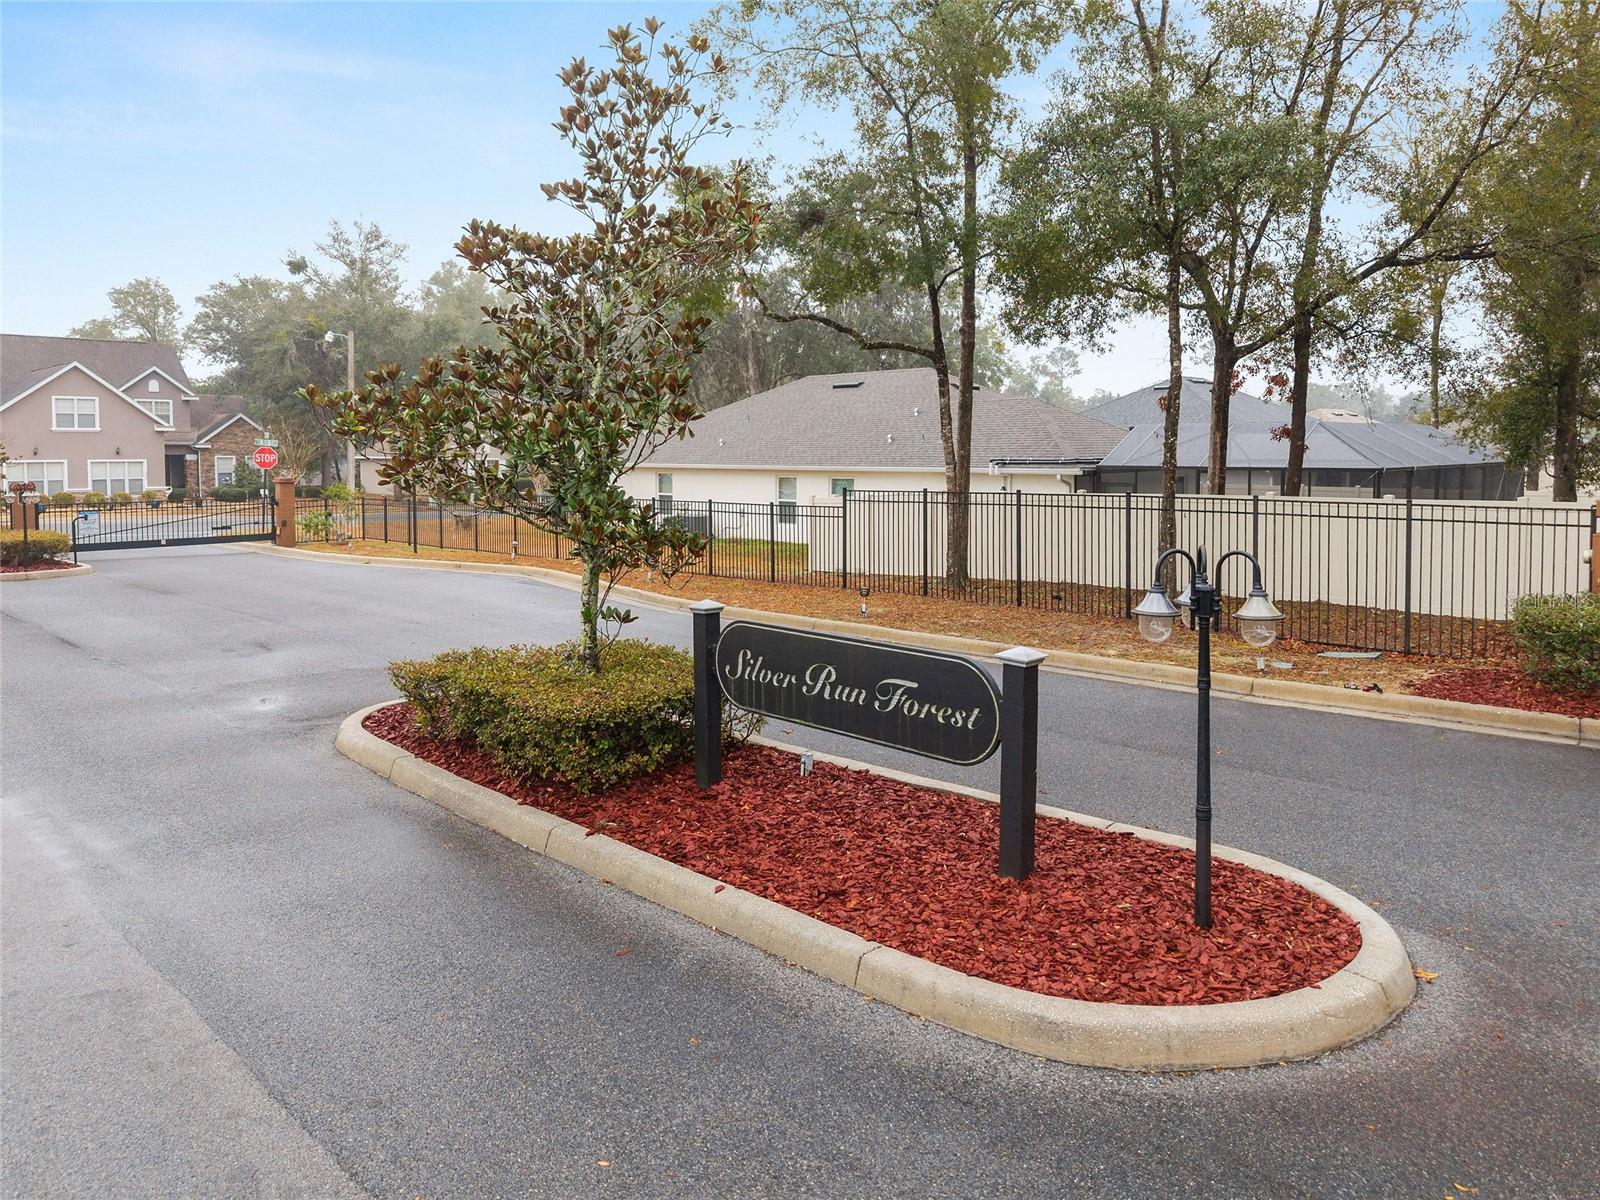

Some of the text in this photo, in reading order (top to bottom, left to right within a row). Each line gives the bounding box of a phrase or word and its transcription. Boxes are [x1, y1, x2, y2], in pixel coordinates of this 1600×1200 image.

[255, 453, 276, 463] STOP
[725, 648, 984, 730] Silver Run Forest
